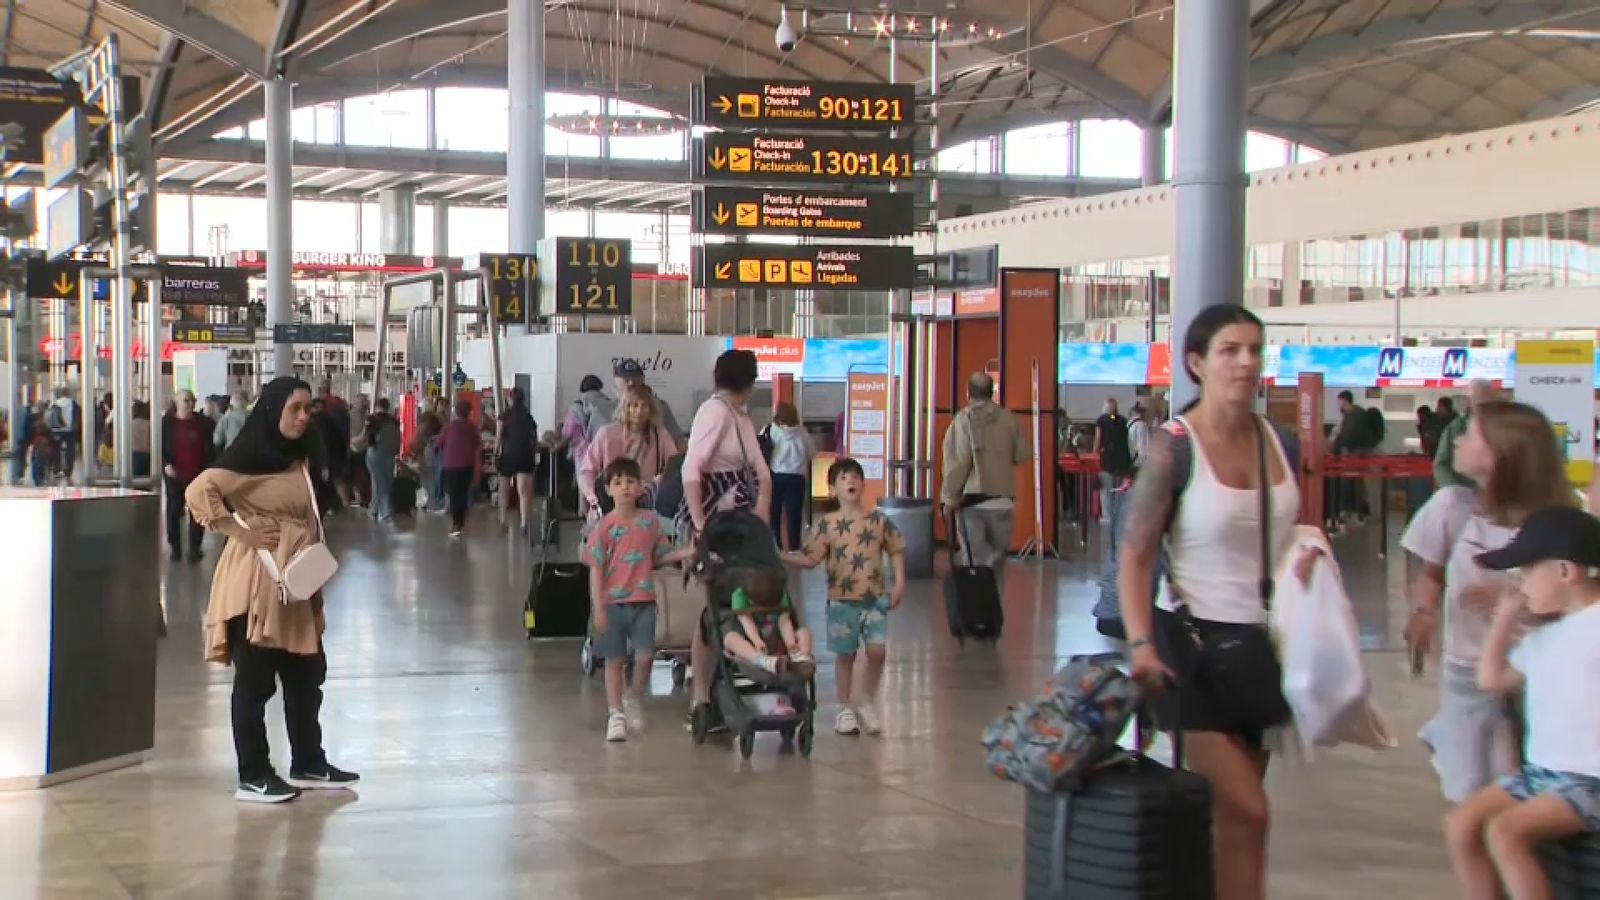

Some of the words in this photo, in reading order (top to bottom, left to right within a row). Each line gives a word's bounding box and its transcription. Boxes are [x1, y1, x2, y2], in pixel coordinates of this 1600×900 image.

[764, 84, 811, 97] Facturació
[764, 96, 799, 106] Check-in
[764, 107, 817, 119] Facturación
[819, 97, 849, 119] 90
[861, 98, 903, 121] 121
[754, 137, 804, 149] Facturació
[754, 149, 791, 160] Check-in
[754, 161, 811, 174] Facturación
[811, 151, 859, 175] 130
[869, 153, 913, 177] 141
[763, 193, 793, 206] Portes
[804, 195, 868, 208] embarcament
[763, 216, 799, 228] Puertas
[801, 217, 813, 228] de
[815, 218, 863, 230] embarque
[292, 252, 348, 265] BURGER
[351, 253, 386, 266] KING
[567, 240, 621, 268] 110
[816, 250, 861, 262] Arribades
[489, 255, 539, 281] 130
[816, 262, 847, 272] Arrivals
[164, 274, 221, 291] barreras
[817, 272, 858, 285] Llegadas
[569, 284, 620, 310] 121
[356, 351, 405, 363] HOSE
[737, 345, 778, 356] yJet
[611, 349, 674, 373] velo
[851, 381, 886, 393] easyJet
